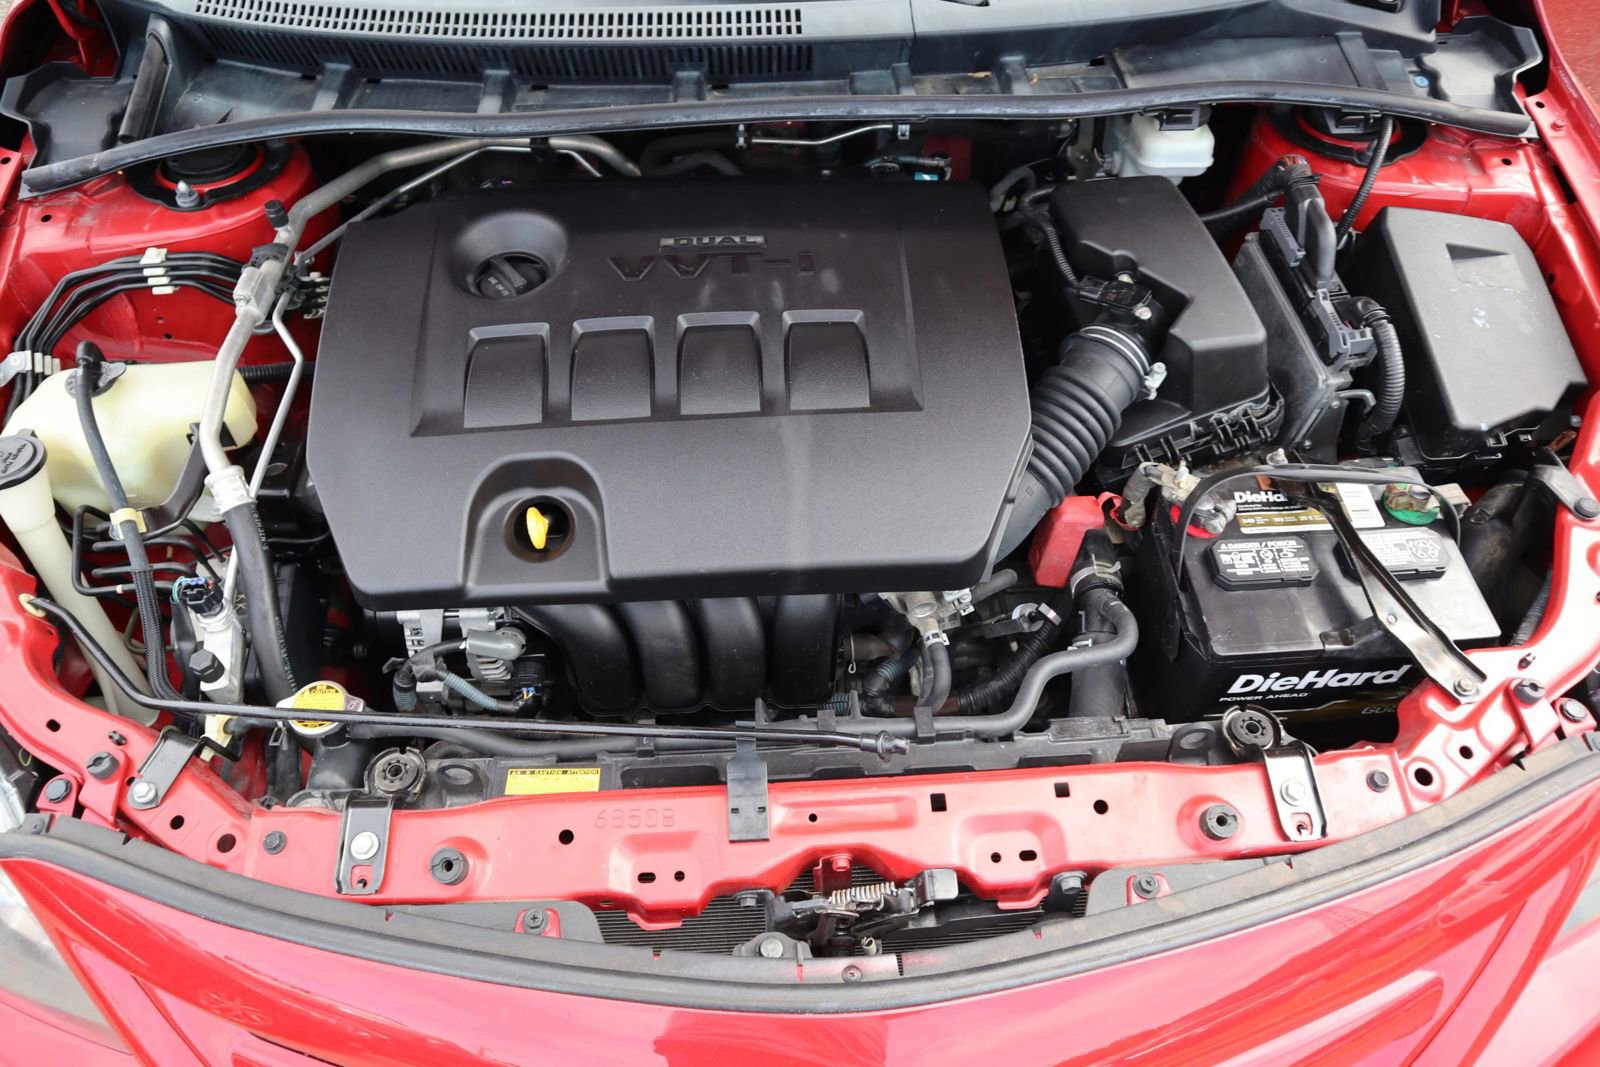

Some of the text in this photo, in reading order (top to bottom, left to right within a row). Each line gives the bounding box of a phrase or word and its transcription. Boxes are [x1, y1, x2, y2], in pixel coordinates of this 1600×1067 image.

[673, 236, 757, 246] DUAL
[1233, 490, 1288, 503] DieHa
[1226, 664, 1413, 694] DieHard
[1218, 692, 1308, 702] POWER AHEAD
